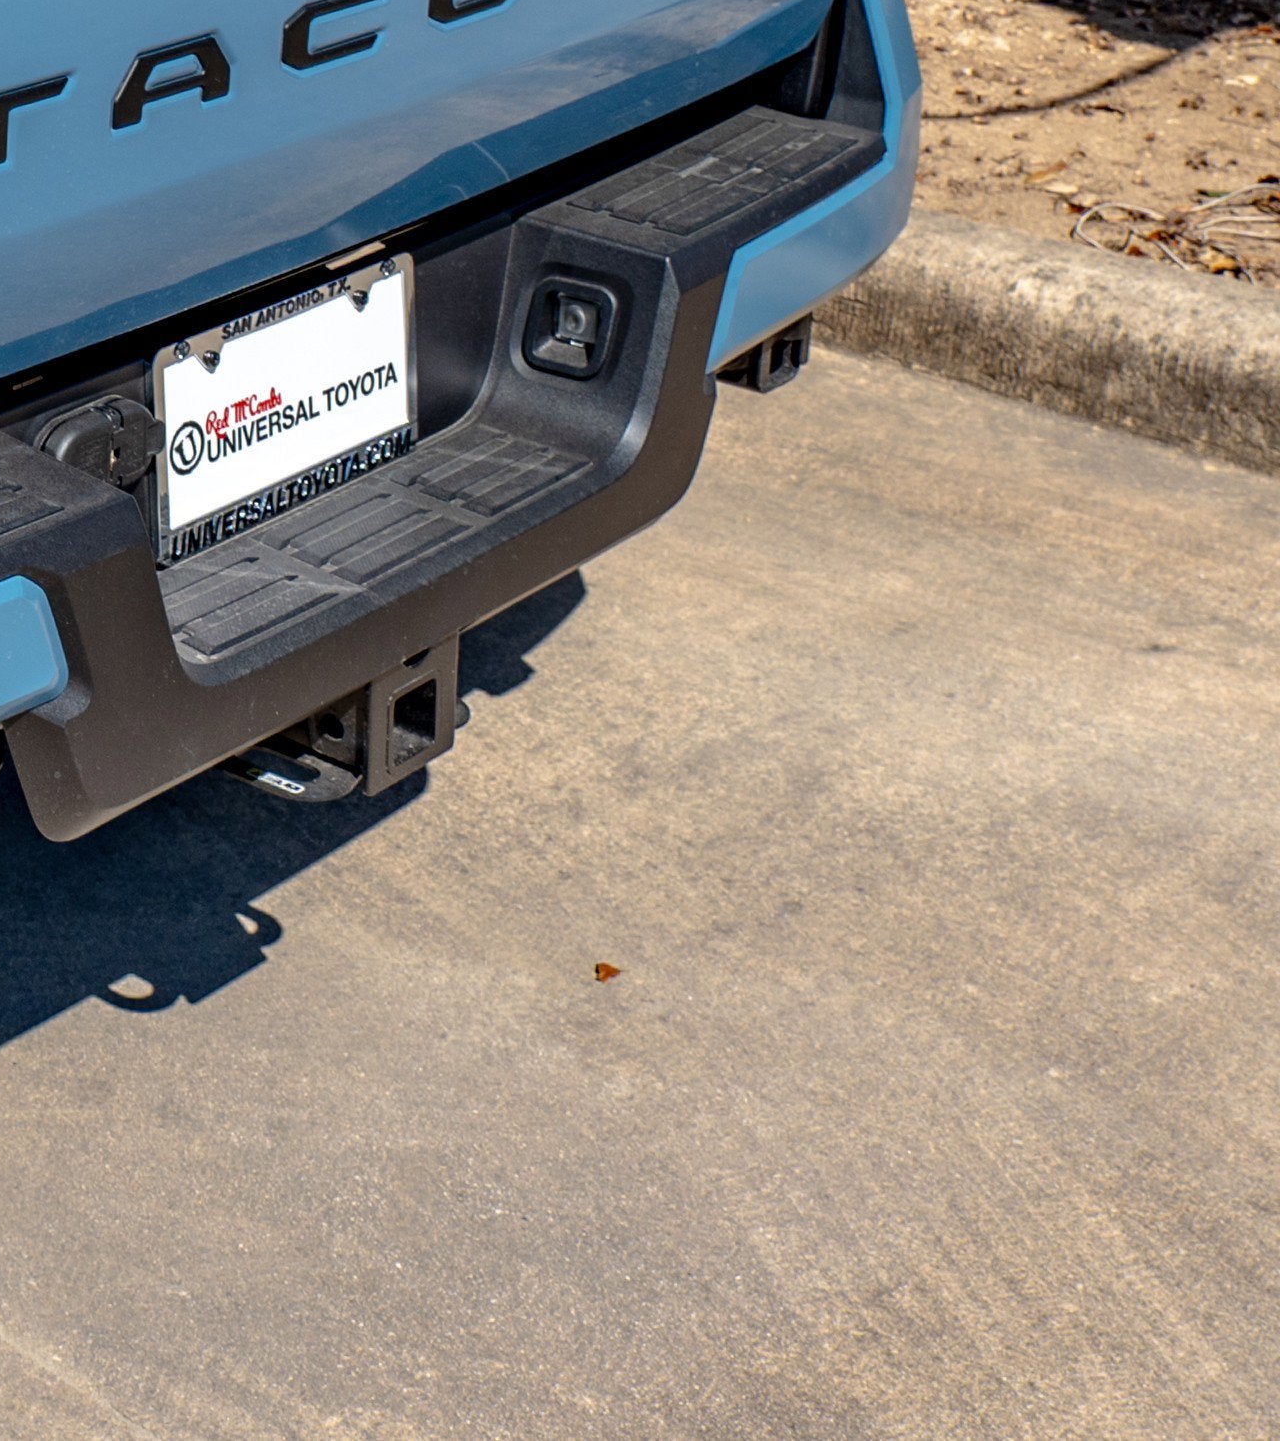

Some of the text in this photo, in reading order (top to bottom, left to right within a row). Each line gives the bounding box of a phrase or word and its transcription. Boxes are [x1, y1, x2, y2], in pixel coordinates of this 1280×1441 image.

[221, 316, 251, 340] SAN
[207, 362, 397, 463] UNIVERSAL TOYOTA
